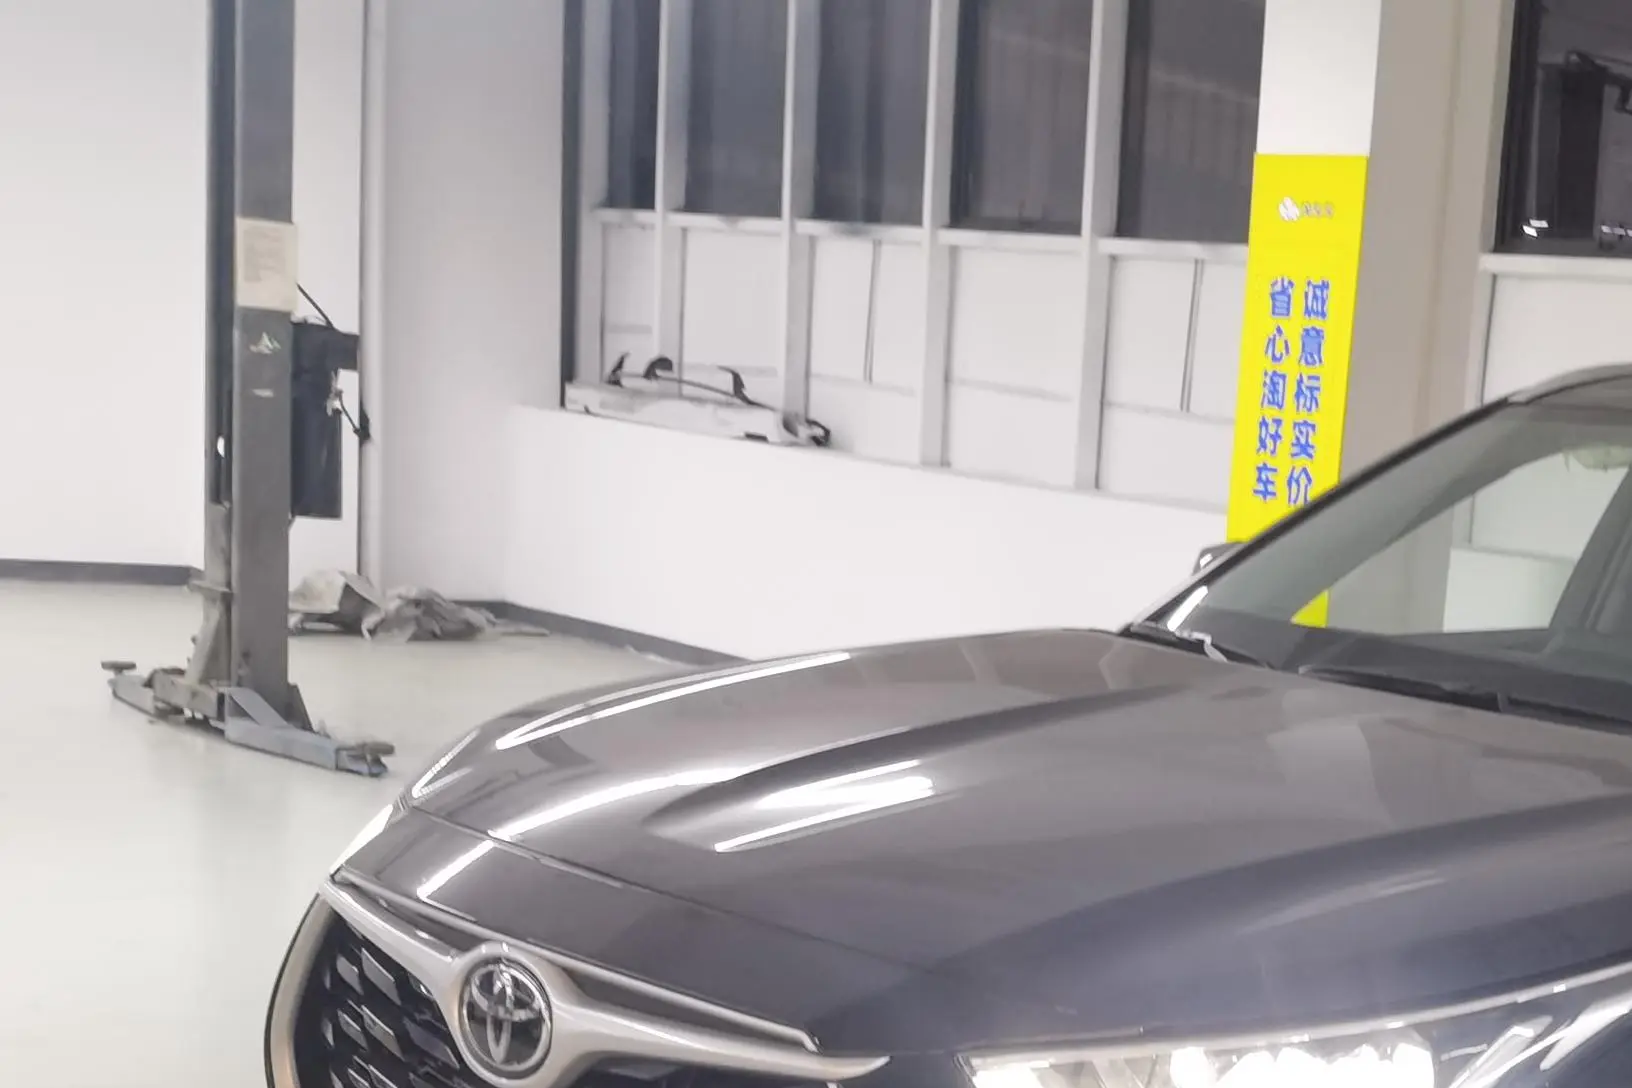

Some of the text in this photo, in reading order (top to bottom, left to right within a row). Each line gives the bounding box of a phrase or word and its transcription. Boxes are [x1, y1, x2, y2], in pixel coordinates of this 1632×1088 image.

[1253, 277, 1294, 502] 省心淘好车
[1287, 280, 1329, 504] 诚意标实价
